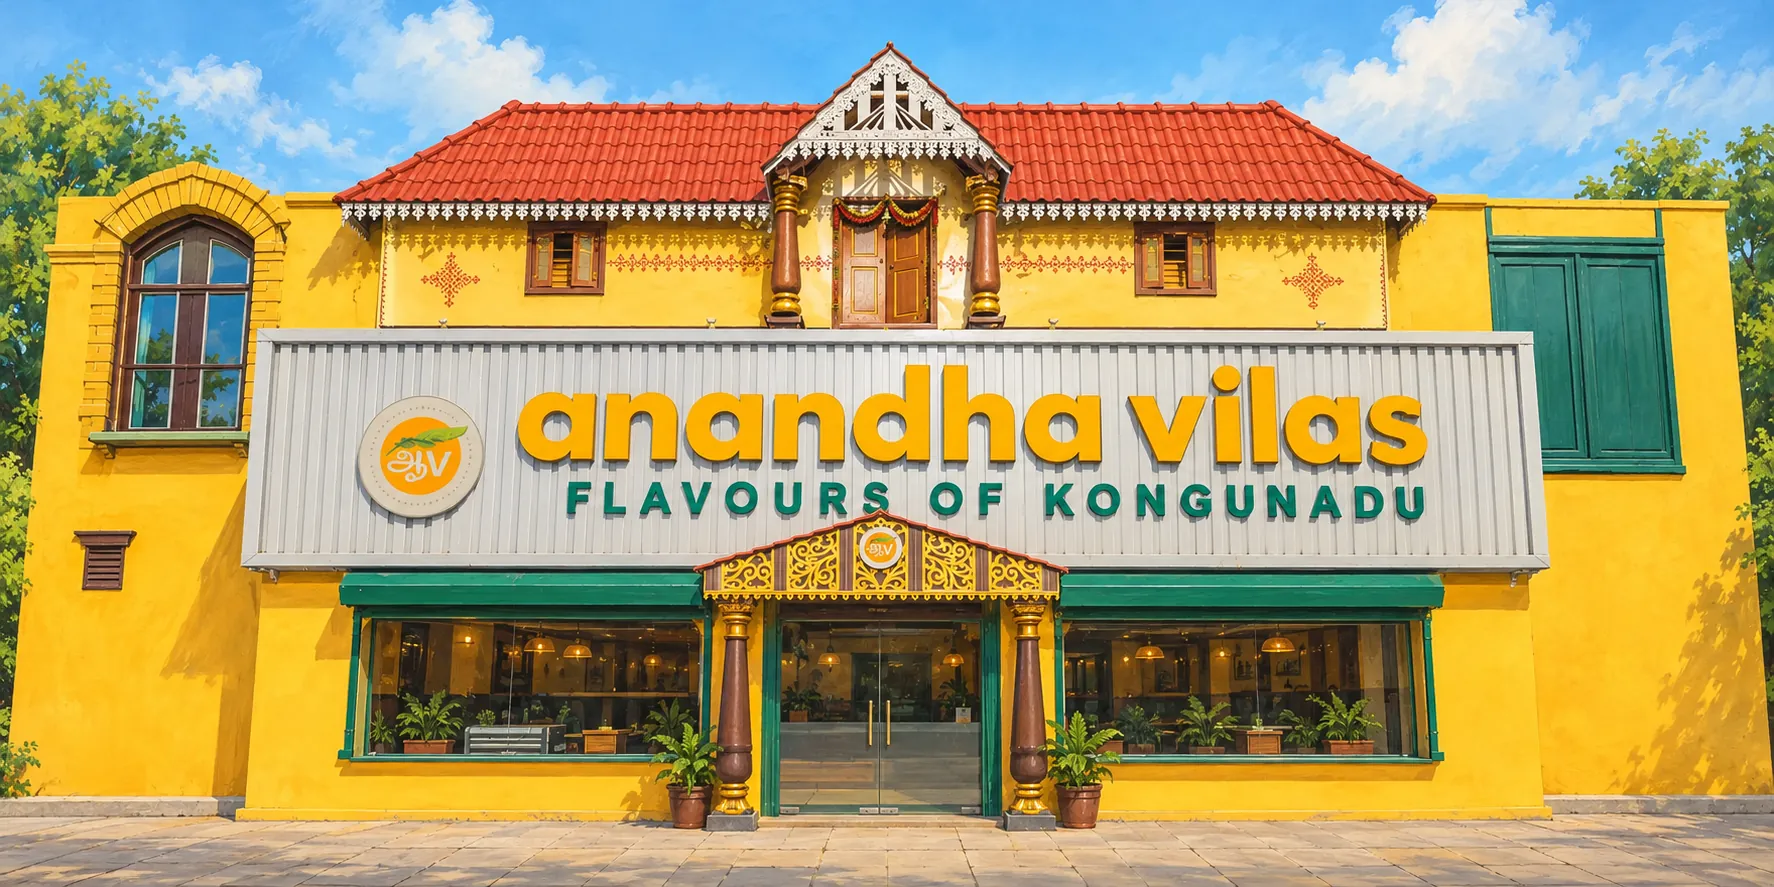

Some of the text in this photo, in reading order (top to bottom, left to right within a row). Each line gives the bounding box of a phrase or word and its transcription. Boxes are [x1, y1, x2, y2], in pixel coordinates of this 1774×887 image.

[518, 364, 1429, 466] anandha vilas
[567, 481, 1425, 520] FLAVOURS OF KONGUNADU
